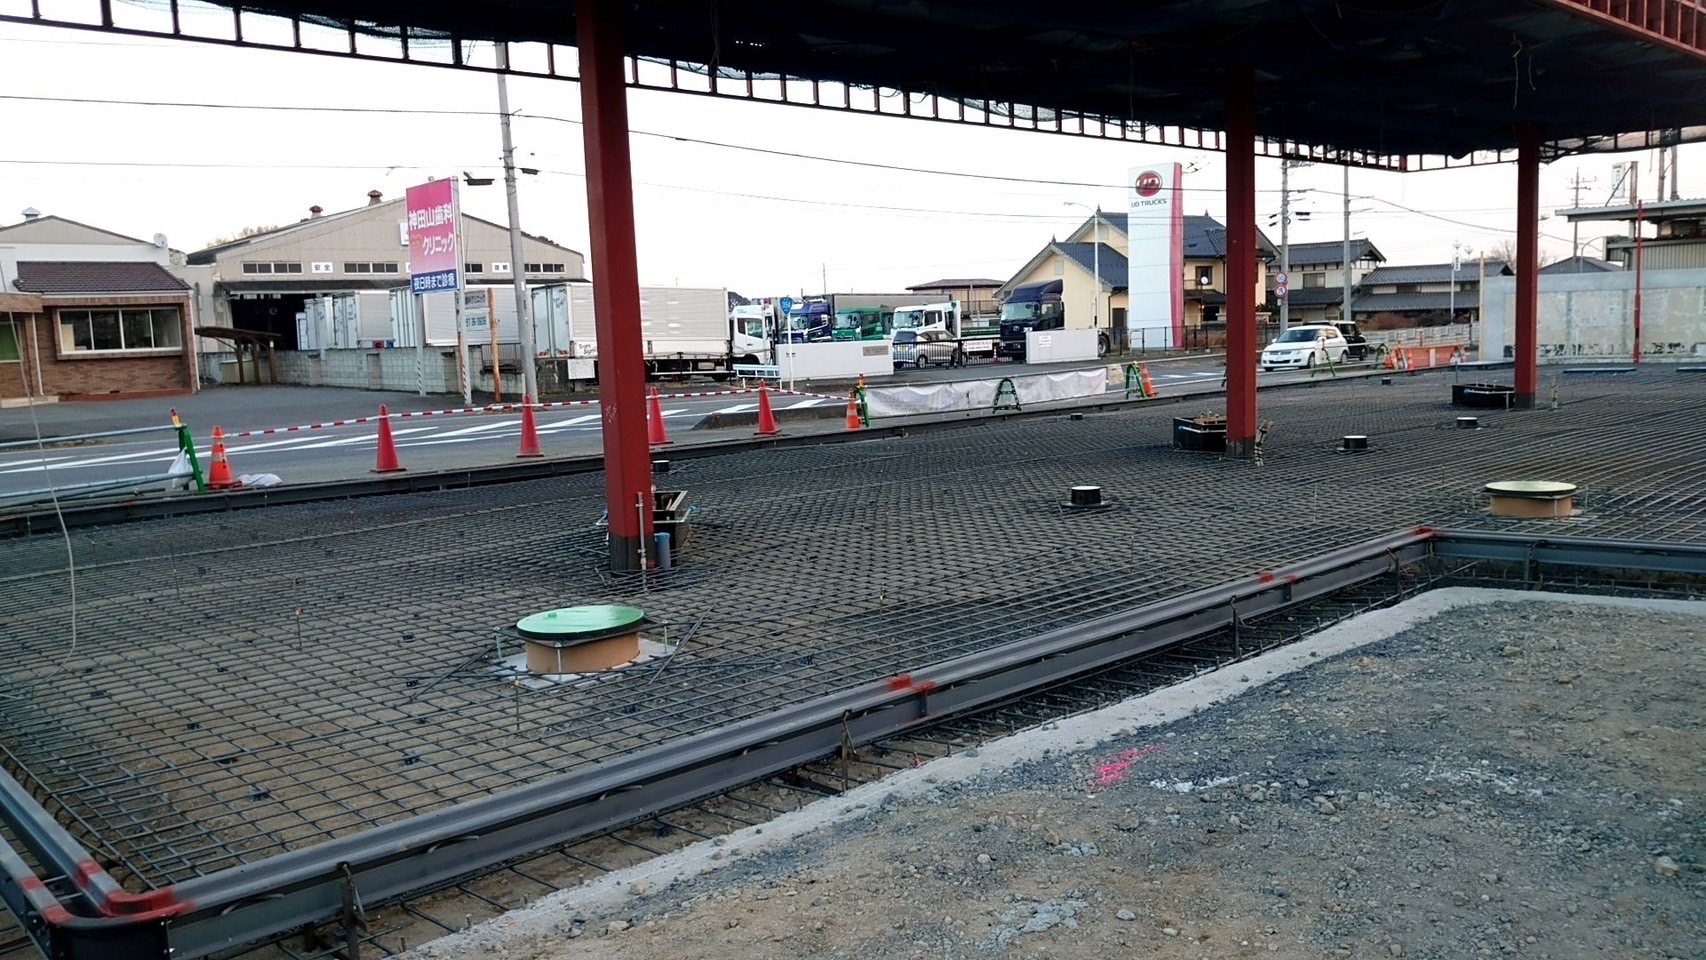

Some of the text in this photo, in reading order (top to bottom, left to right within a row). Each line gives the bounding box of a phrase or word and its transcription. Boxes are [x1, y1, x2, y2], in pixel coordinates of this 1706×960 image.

[1140, 198, 1167, 207] TRUCKS
[408, 202, 453, 231] 神田山歯科
[422, 231, 454, 256] クリニック
